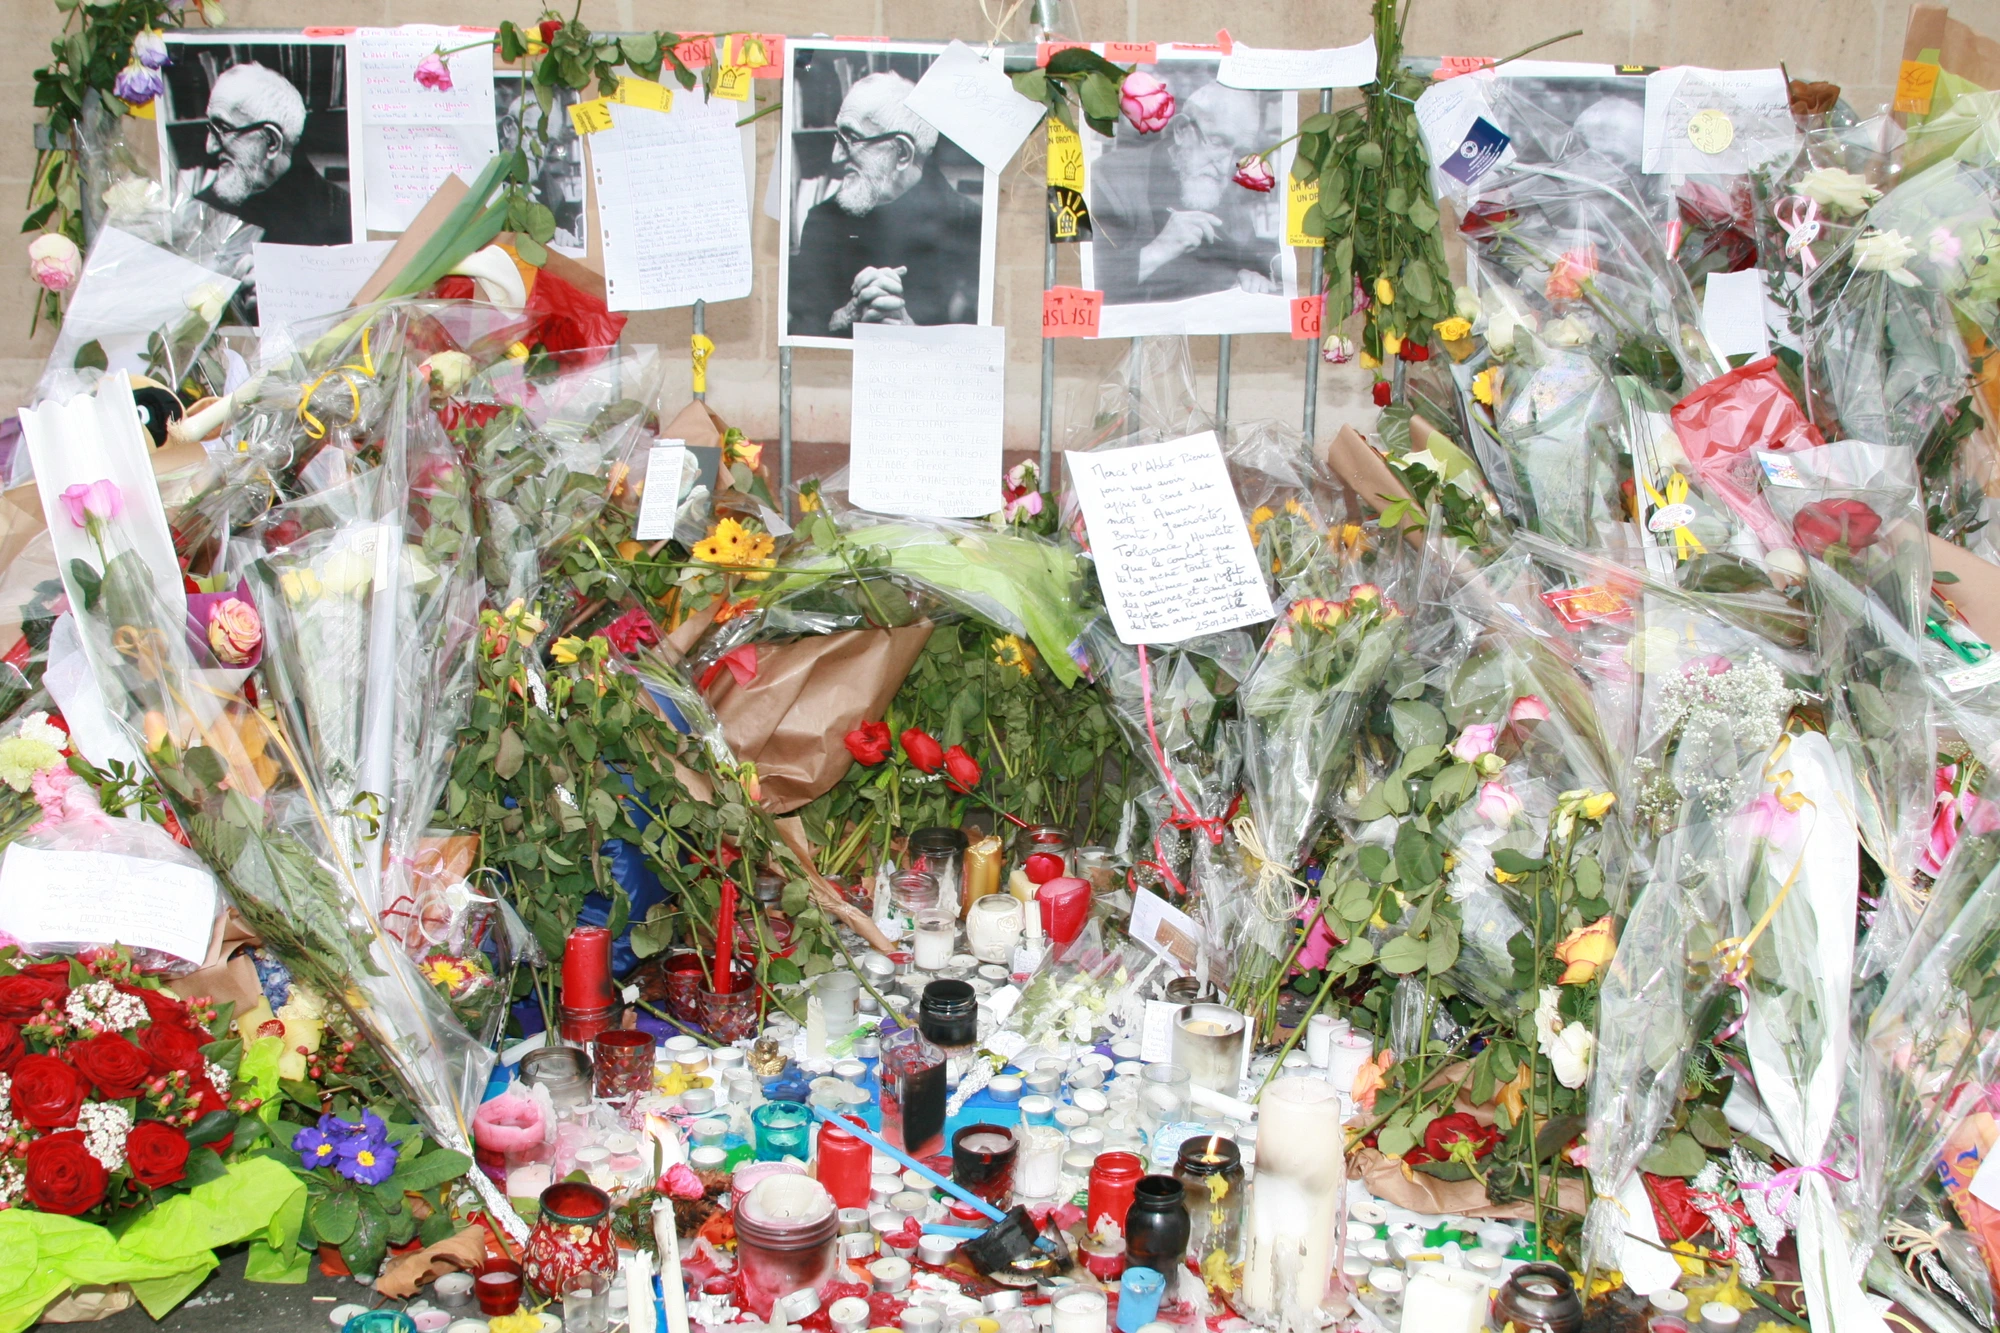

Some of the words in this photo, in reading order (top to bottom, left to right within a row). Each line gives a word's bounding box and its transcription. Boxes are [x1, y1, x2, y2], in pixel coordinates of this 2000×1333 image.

[1056, 136, 1072, 144] DROIT
[1091, 463, 1128, 480] Merci
[1179, 452, 1216, 464] Pierre
[1100, 486, 1124, 498] pour
[1158, 476, 1186, 486] avoir
[1104, 499, 1136, 514] appris
[1142, 493, 1154, 504] le
[1160, 491, 1183, 502] sens
[1190, 482, 1215, 492] des
[1152, 556, 1164, 568] le
[1168, 544, 1208, 564] combat
[1212, 544, 1236, 555] que
[1184, 558, 1212, 573] toute
[1192, 576, 1209, 584] au
[1214, 564, 1246, 583] profit
[1122, 598, 1140, 609] des
[1144, 594, 1182, 612] pauvres
[1188, 586, 1199, 596] et
[1167, 606, 1180, 614] en
[1182, 598, 1209, 609] Paix
[1130, 620, 1146, 630] de
[1150, 619, 1169, 630] ton
[1173, 614, 1197, 625] ami
